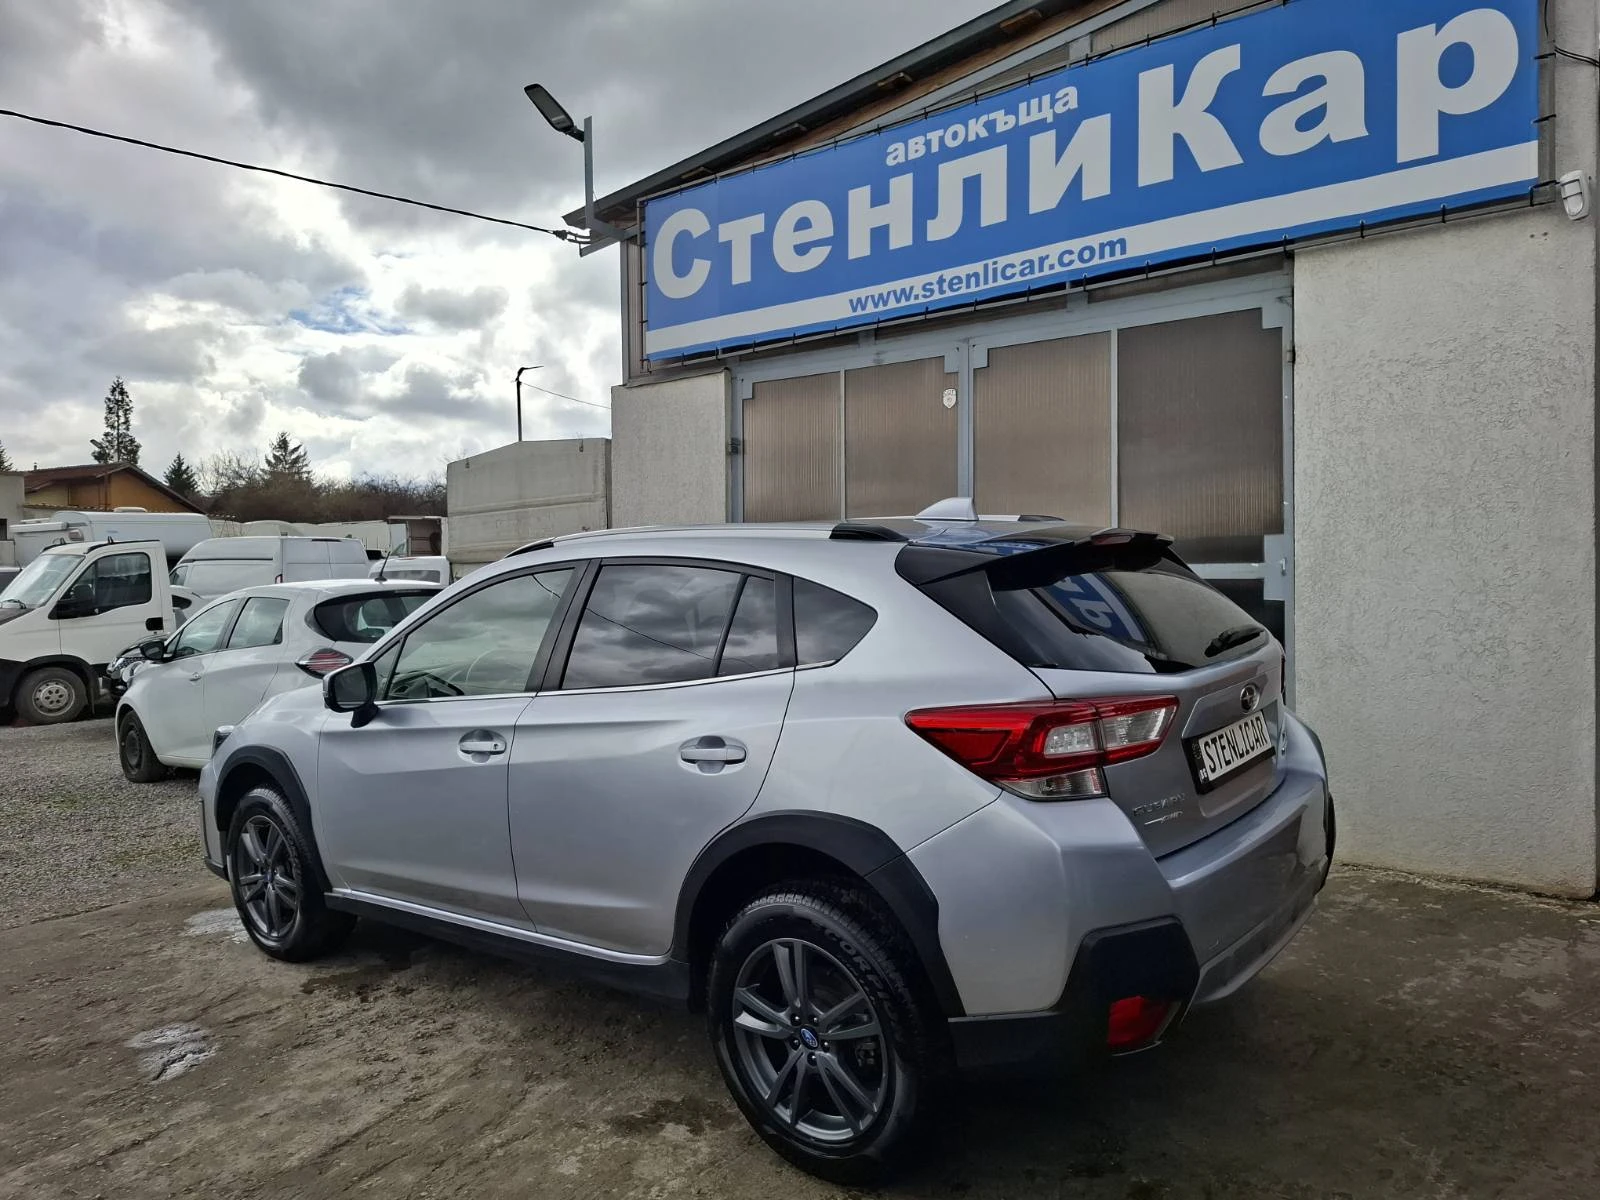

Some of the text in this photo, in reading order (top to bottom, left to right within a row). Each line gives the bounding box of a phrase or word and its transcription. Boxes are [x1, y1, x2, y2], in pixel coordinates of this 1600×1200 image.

[653, 8, 1520, 300] СтенлиКар
[886, 85, 1079, 166] автокъща
[849, 236, 1128, 314] www.stenlicar.com
[1203, 716, 1267, 774] STENLICAR
